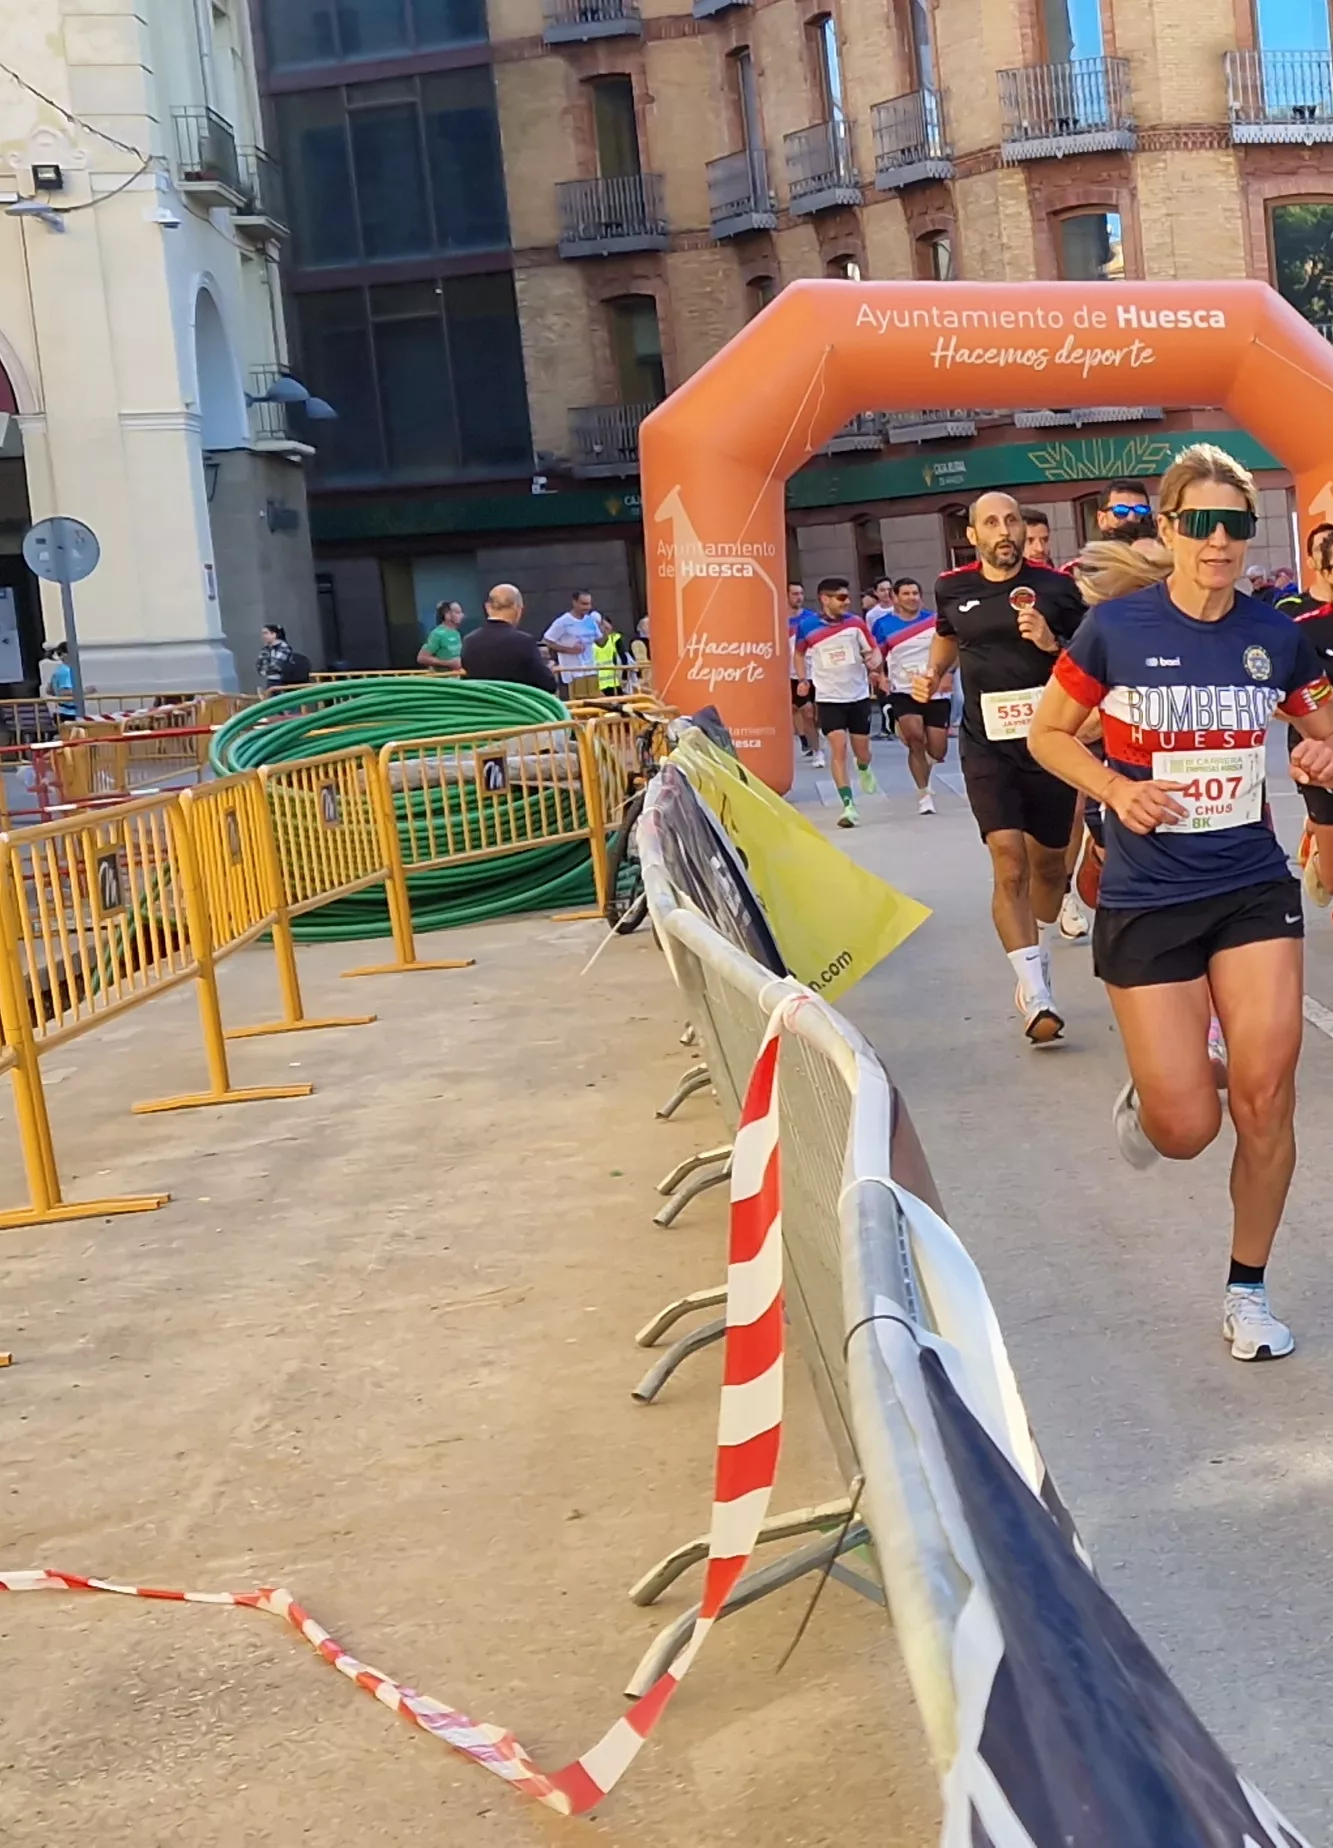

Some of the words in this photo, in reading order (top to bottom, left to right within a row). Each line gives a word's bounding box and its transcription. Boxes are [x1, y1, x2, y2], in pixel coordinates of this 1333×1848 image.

[855, 303, 1064, 333] Ayuntamiento
[1073, 305, 1108, 329] de
[1116, 305, 1226, 329] Huesca
[930, 335, 1050, 371] Hacemos
[1054, 335, 1156, 378] deporte
[657, 540, 776, 560] Ayuntamiento
[658, 562, 675, 578] de
[681, 561, 754, 578] Huesca
[685, 632, 774, 659] Hacemos
[687, 654, 765, 692] deporte
[997, 703, 1034, 719] 553
[1128, 686, 1280, 731] BOMBEROS
[1131, 726, 1265, 749] HUESC
[1183, 775, 1243, 802] 407
[1195, 803, 1233, 816] CHUS
